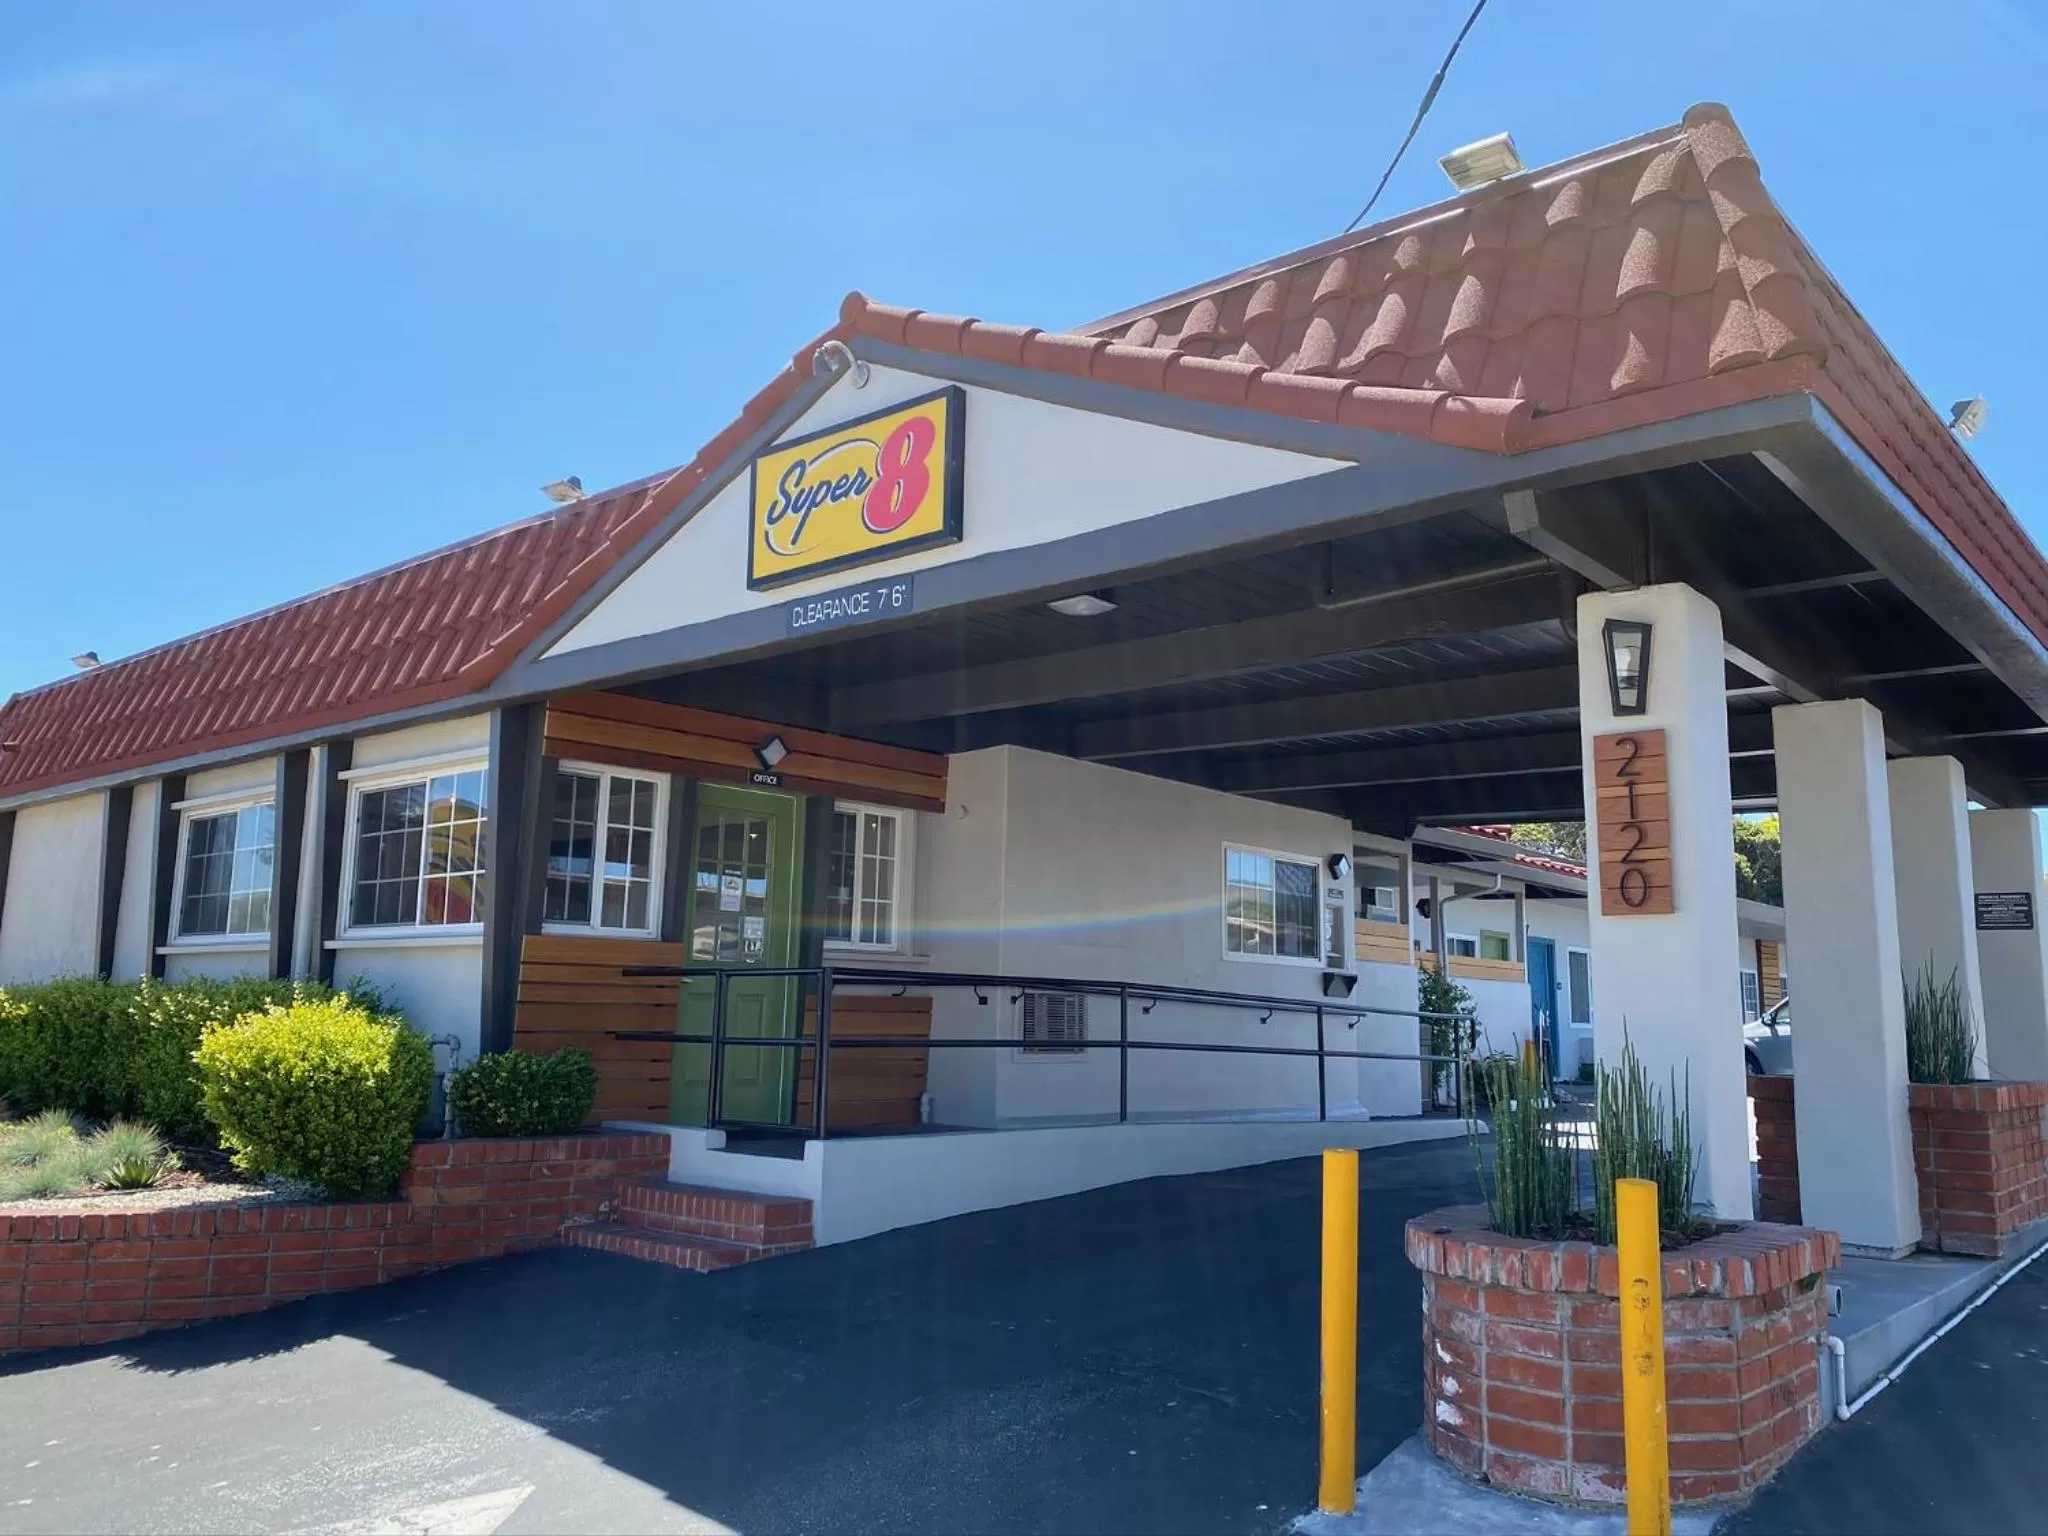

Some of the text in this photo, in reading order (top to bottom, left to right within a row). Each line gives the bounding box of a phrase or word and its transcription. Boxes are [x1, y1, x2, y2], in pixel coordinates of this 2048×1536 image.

[766, 416, 936, 546] Super 8
[792, 592, 870, 627] CLEARANCE
[753, 773, 777, 785] OFFICE
[1615, 737, 1648, 908] 2120
